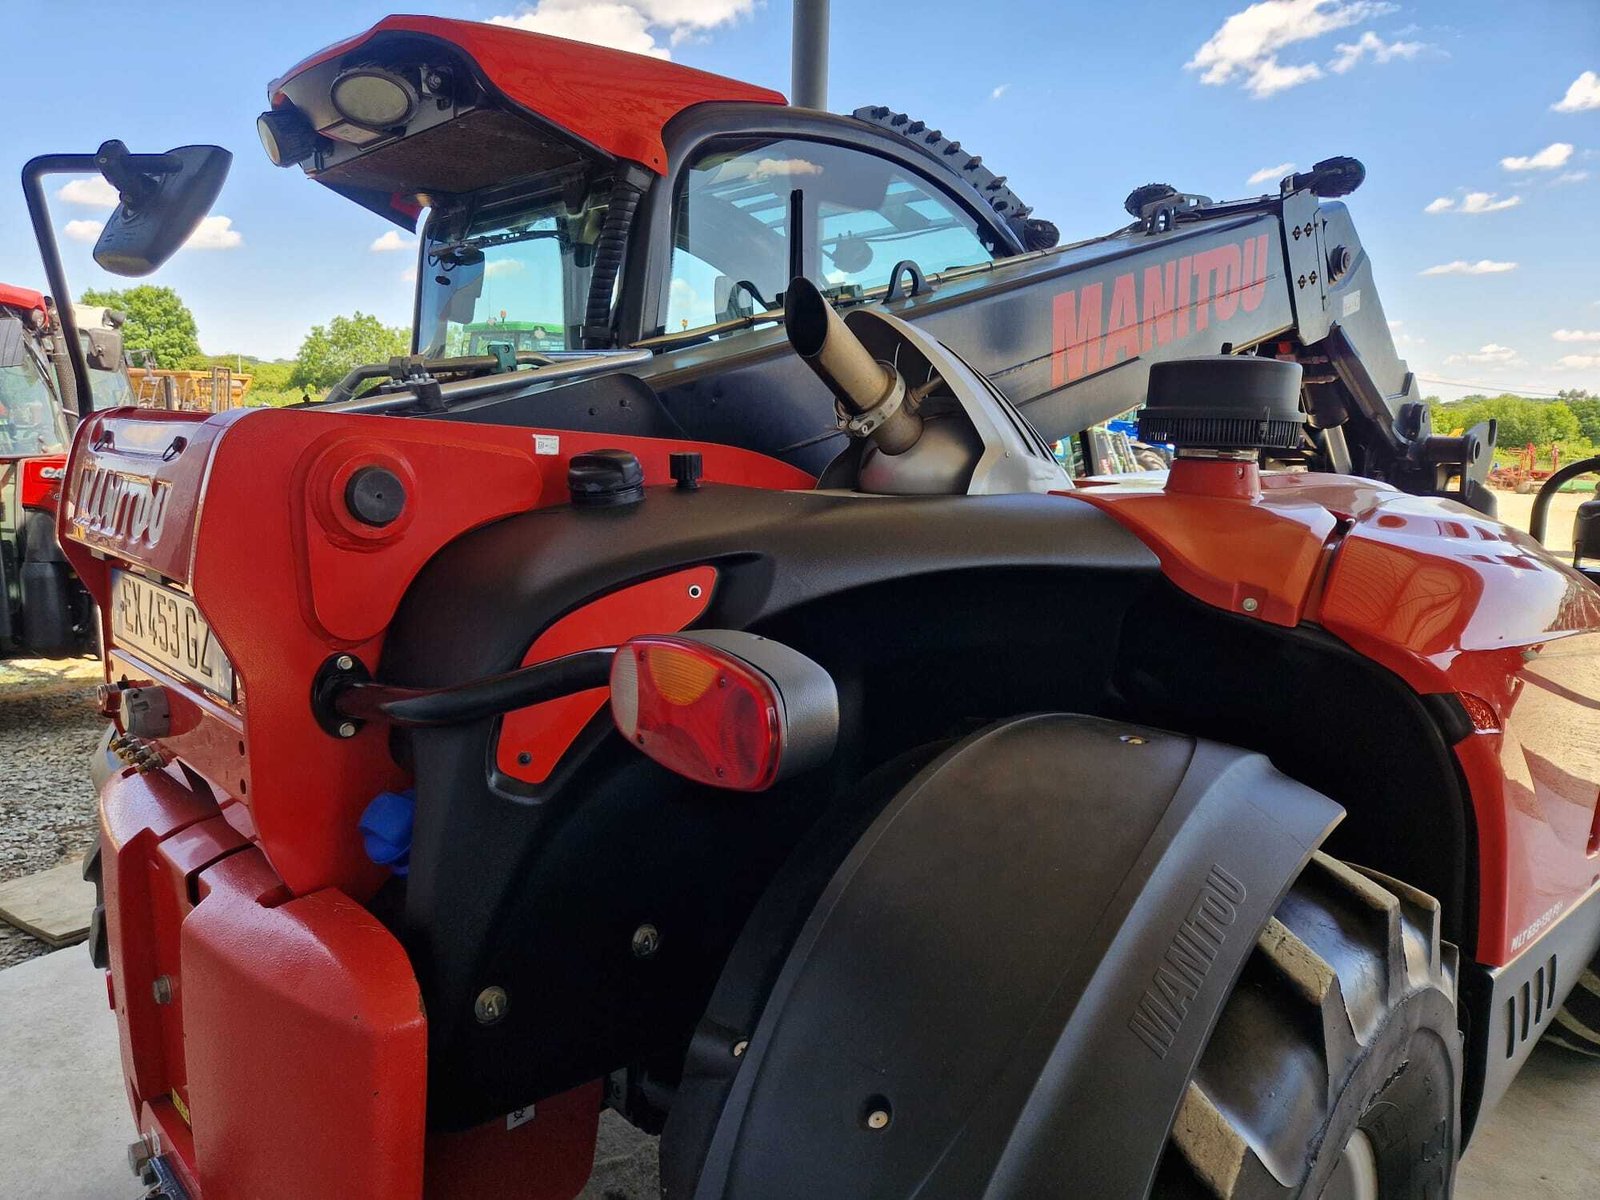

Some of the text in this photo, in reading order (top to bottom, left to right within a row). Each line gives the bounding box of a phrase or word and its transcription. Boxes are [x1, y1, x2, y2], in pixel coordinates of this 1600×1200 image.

[1052, 233, 1269, 388] MANITOU
[74, 467, 173, 549] MANITOU
[122, 576, 213, 678] EX 453 GZ
[1128, 862, 1247, 1060] MANITOU
